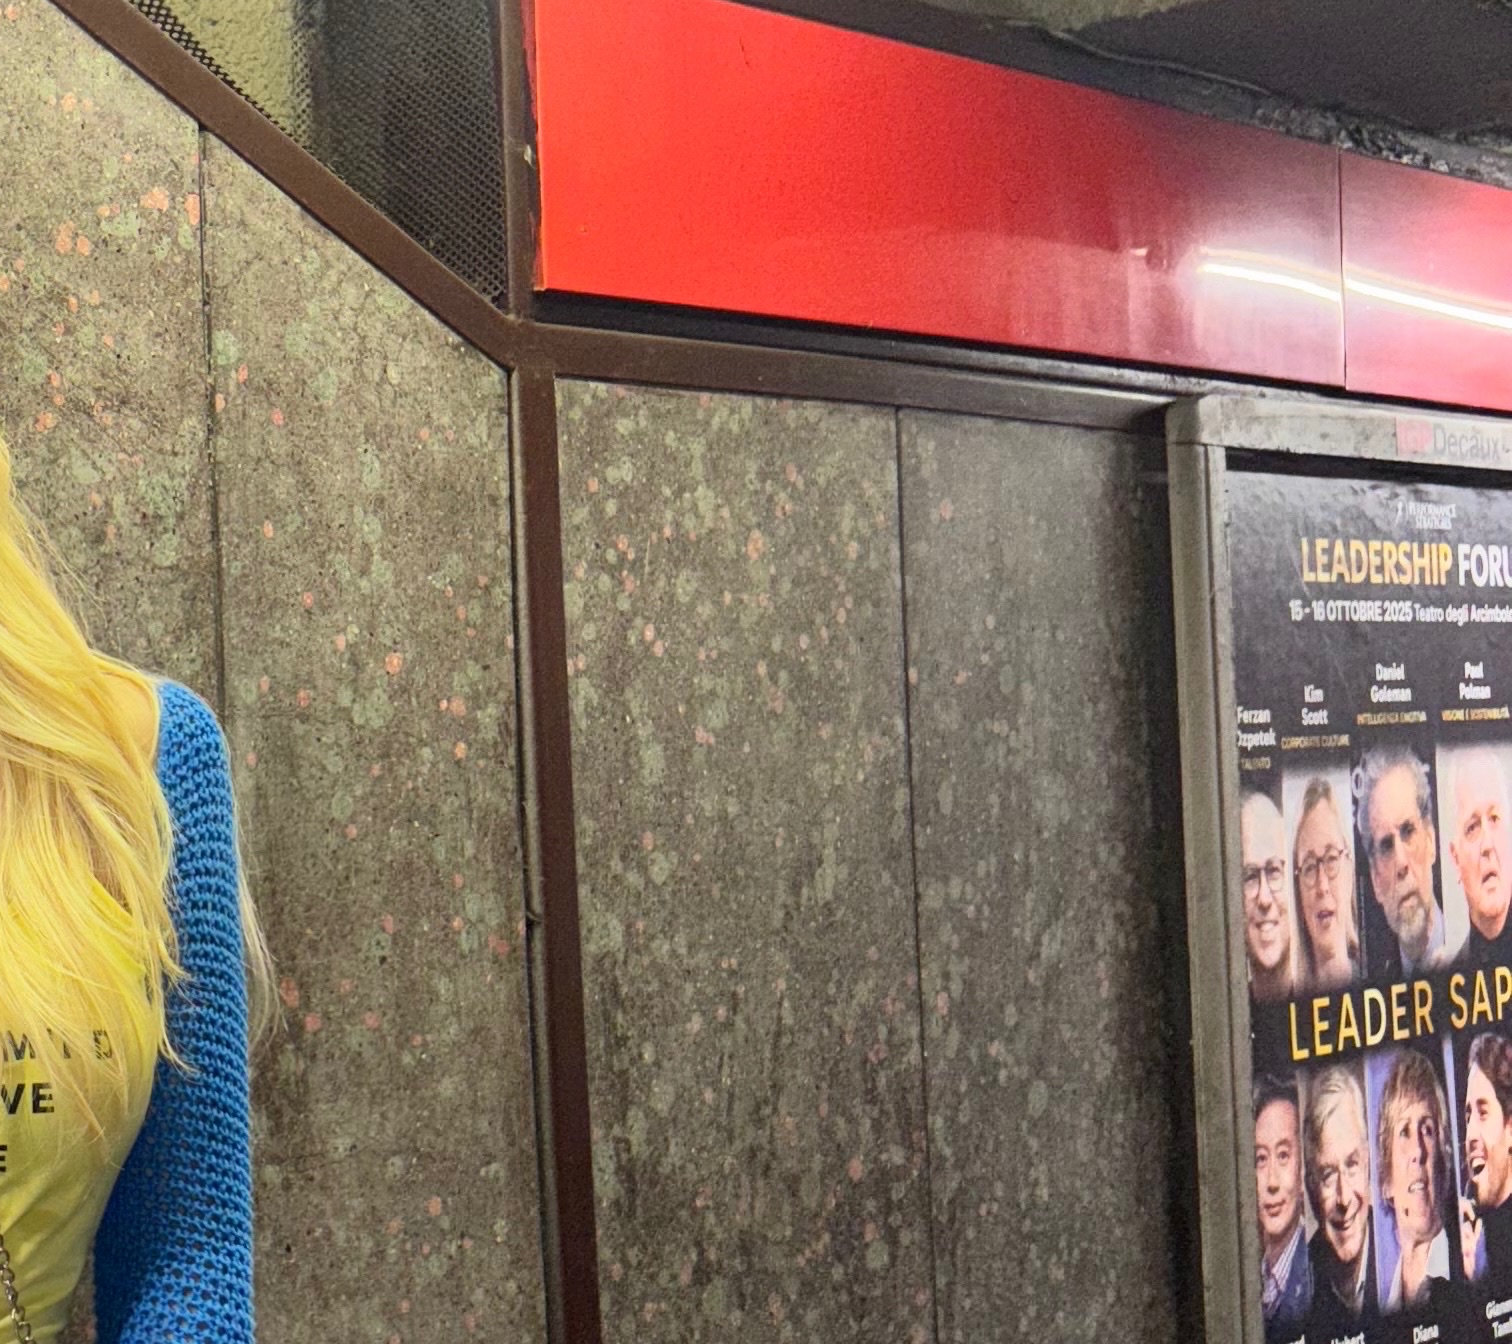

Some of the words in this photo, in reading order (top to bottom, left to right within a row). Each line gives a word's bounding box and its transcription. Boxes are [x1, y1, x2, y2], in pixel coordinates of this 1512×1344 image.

[1302, 537, 1453, 586] LEADERSHIP
[1326, 600, 1382, 622] OTTOBRE
[1383, 600, 1413, 622] 2025
[1414, 604, 1444, 622] Teatro
[1301, 707, 1328, 725] Scott
[1289, 979, 1434, 1062] LEADER
[1413, 1324, 1439, 1344] Diana
